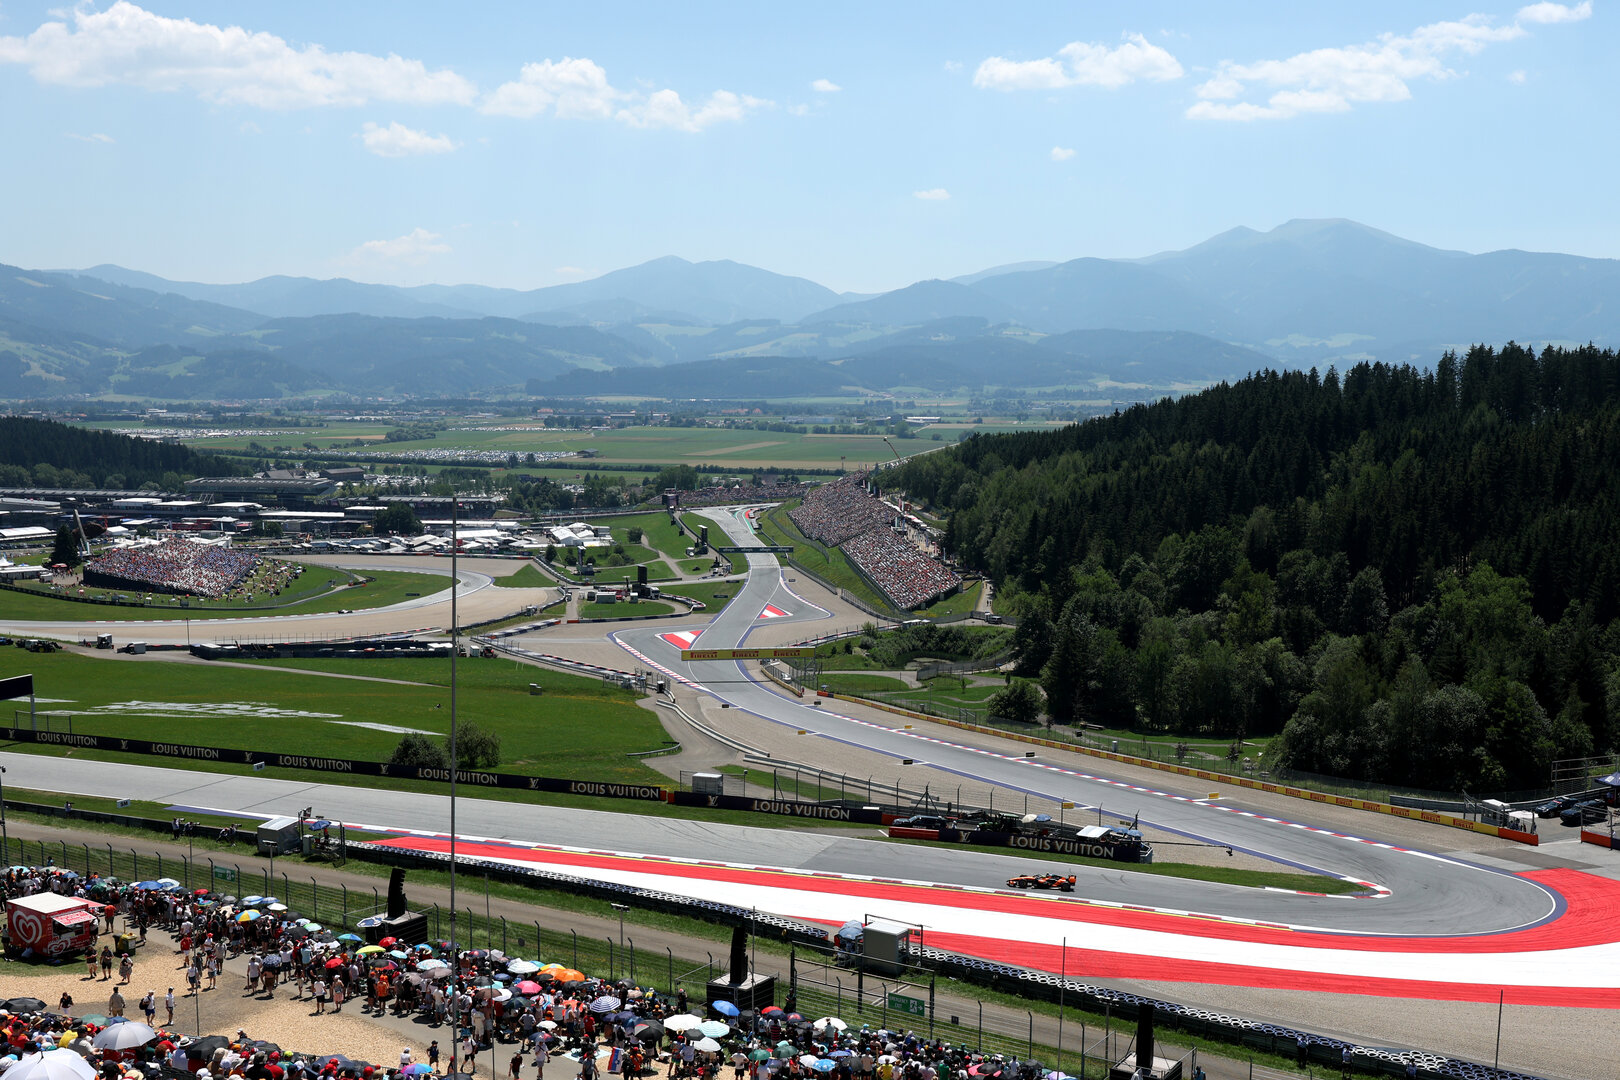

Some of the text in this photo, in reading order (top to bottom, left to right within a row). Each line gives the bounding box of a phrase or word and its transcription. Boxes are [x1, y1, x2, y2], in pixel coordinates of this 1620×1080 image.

[36, 732, 98, 746] LOUIS VUITTON
[152, 743, 219, 758] LOUIS VUITTON
[279, 755, 352, 771] LOUIS VUITTON
[418, 767, 450, 780] LOUIS
[571, 781, 659, 799] LOUIS VUITTON
[753, 799, 850, 820] LOUIS VUITTON
[1453, 818, 1474, 830] PIRELLI
[1010, 835, 1114, 858] LOUIS VUITTON
